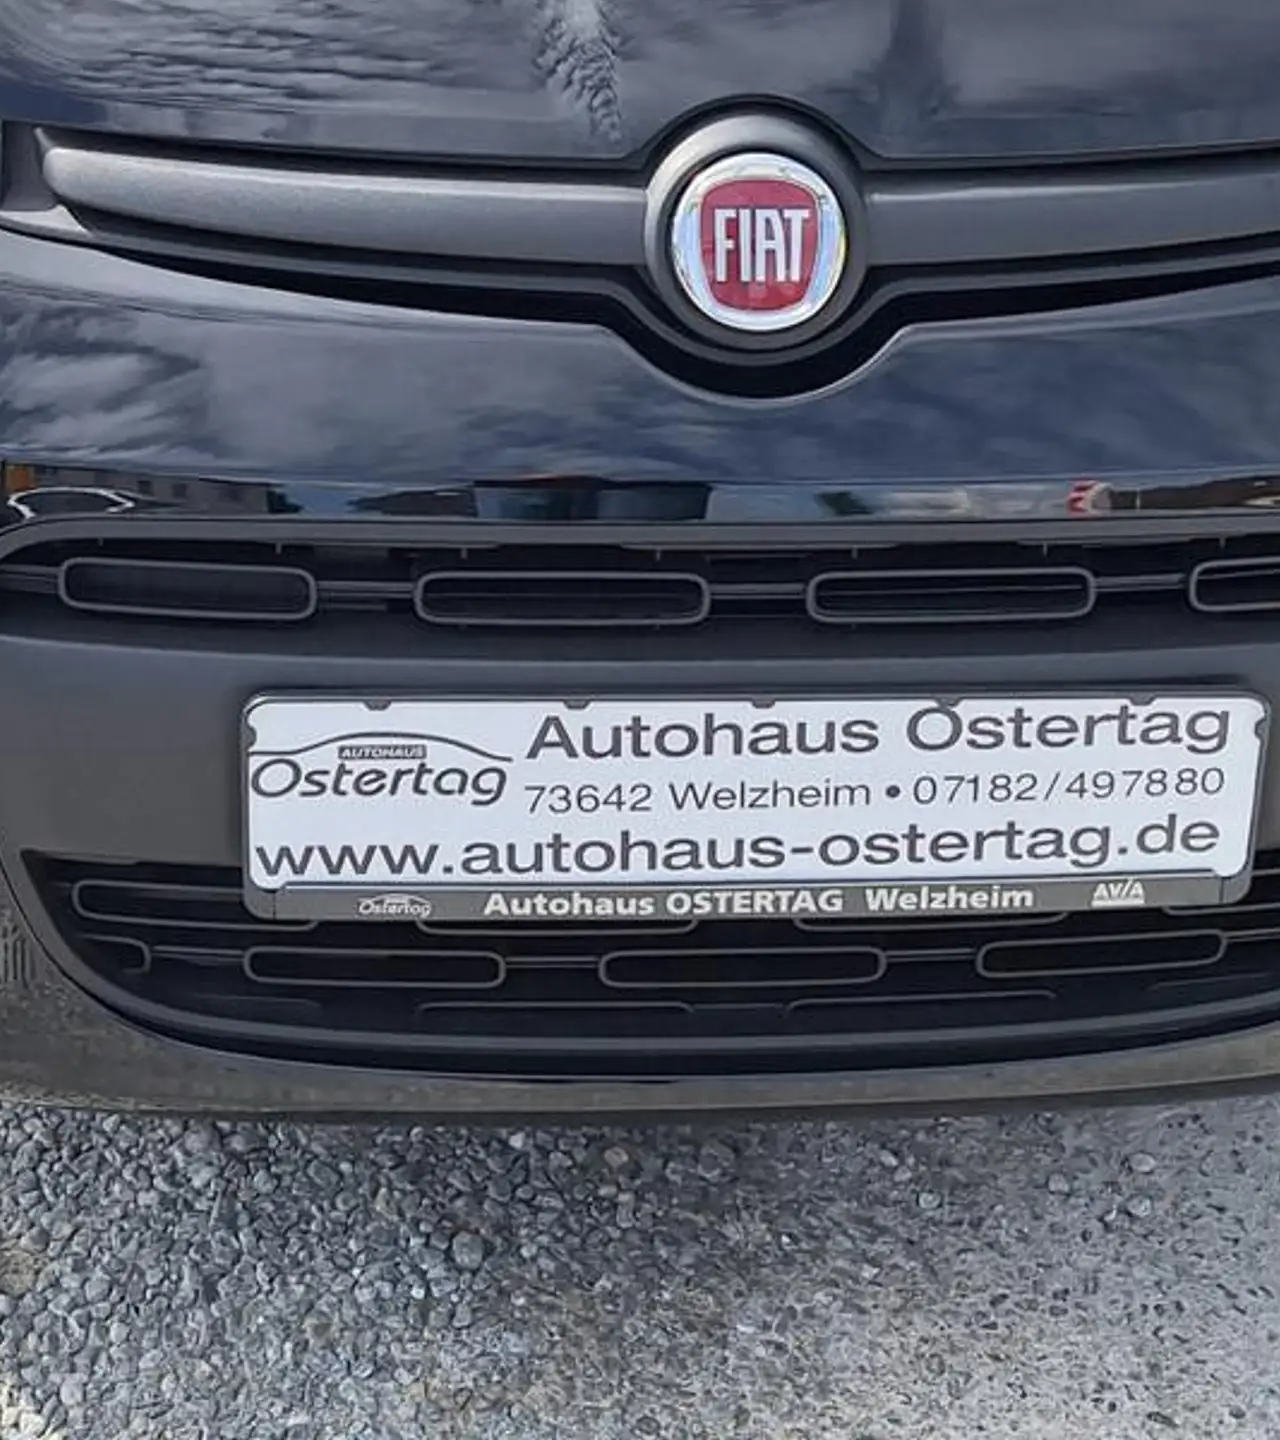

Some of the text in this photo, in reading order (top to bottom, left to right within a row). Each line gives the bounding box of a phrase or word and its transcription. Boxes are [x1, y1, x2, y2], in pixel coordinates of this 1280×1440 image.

[714, 209, 810, 282] FIAT
[341, 747, 424, 758] AUTOHAUS
[526, 706, 1230, 759] Autohaus Ostertag
[251, 759, 507, 806] Ostertag
[524, 784, 652, 813] 73642
[669, 778, 870, 810] Welzheim
[255, 814, 1220, 875] www.autohaus-ostertag.de
[358, 899, 431, 918] Ostertag
[483, 884, 1034, 916] Autohaus OSTERTAG Welzheim
